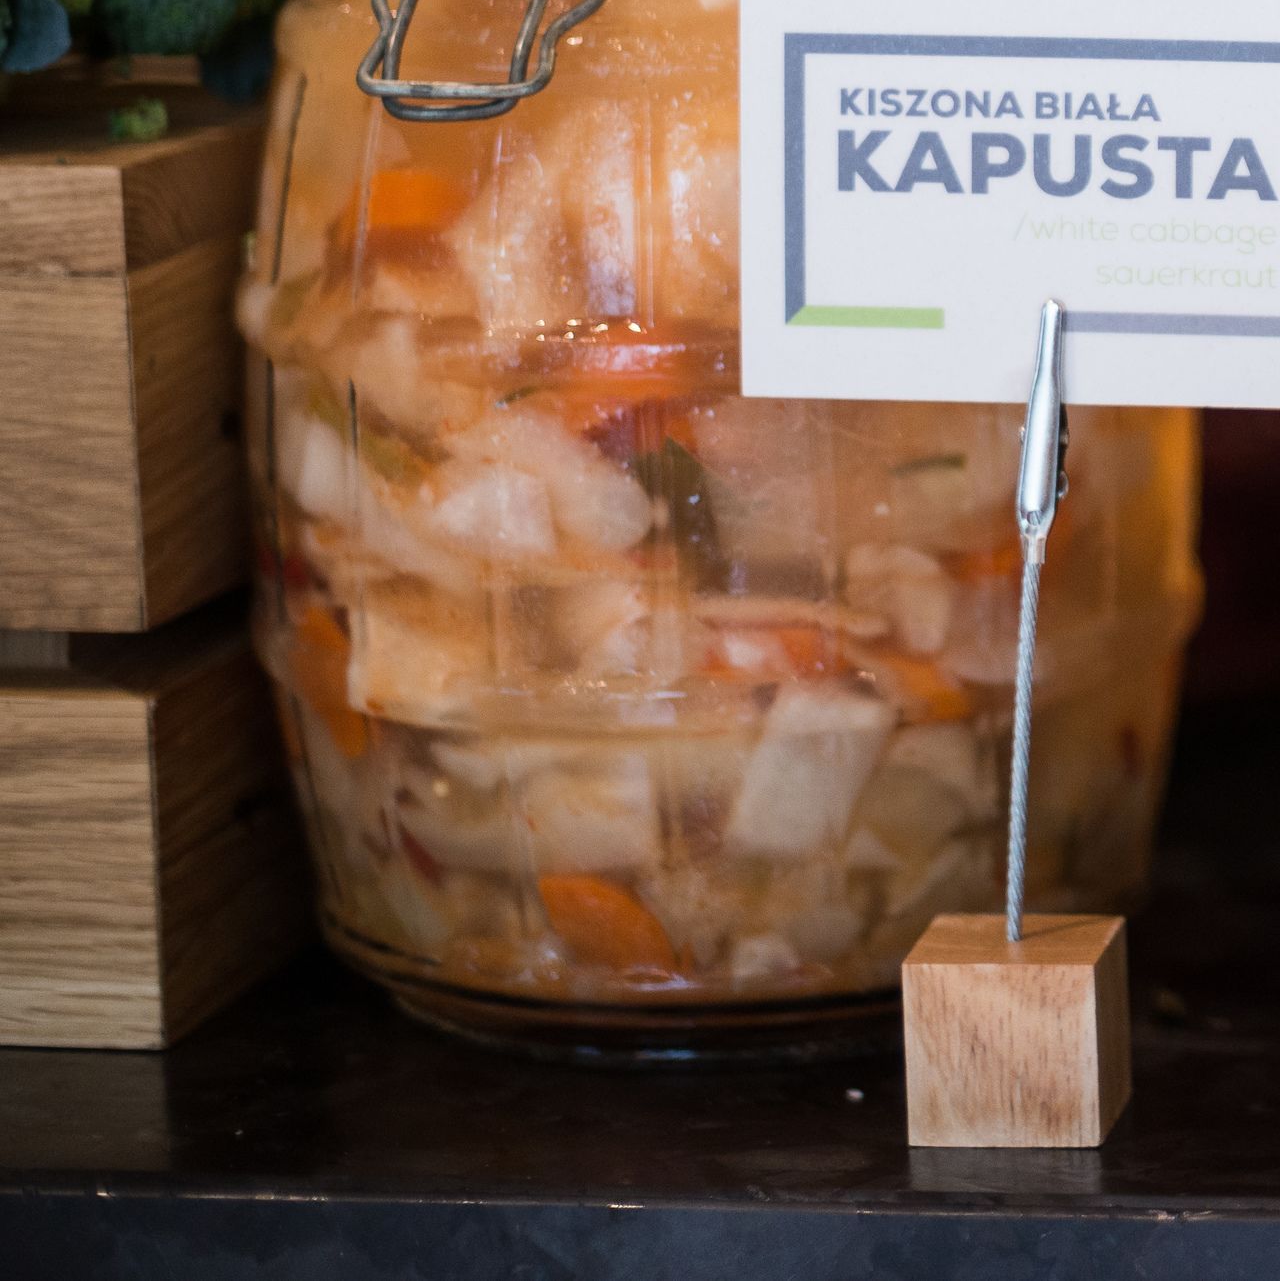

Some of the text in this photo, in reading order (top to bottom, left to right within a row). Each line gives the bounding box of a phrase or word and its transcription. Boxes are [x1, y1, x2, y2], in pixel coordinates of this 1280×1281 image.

[840, 87, 1161, 122] KISZONA BIAŁA
[837, 129, 1279, 202] KAPUSTA
[1012, 215, 1278, 256] /white cabbage
[1095, 263, 1277, 289] sauerkraut
